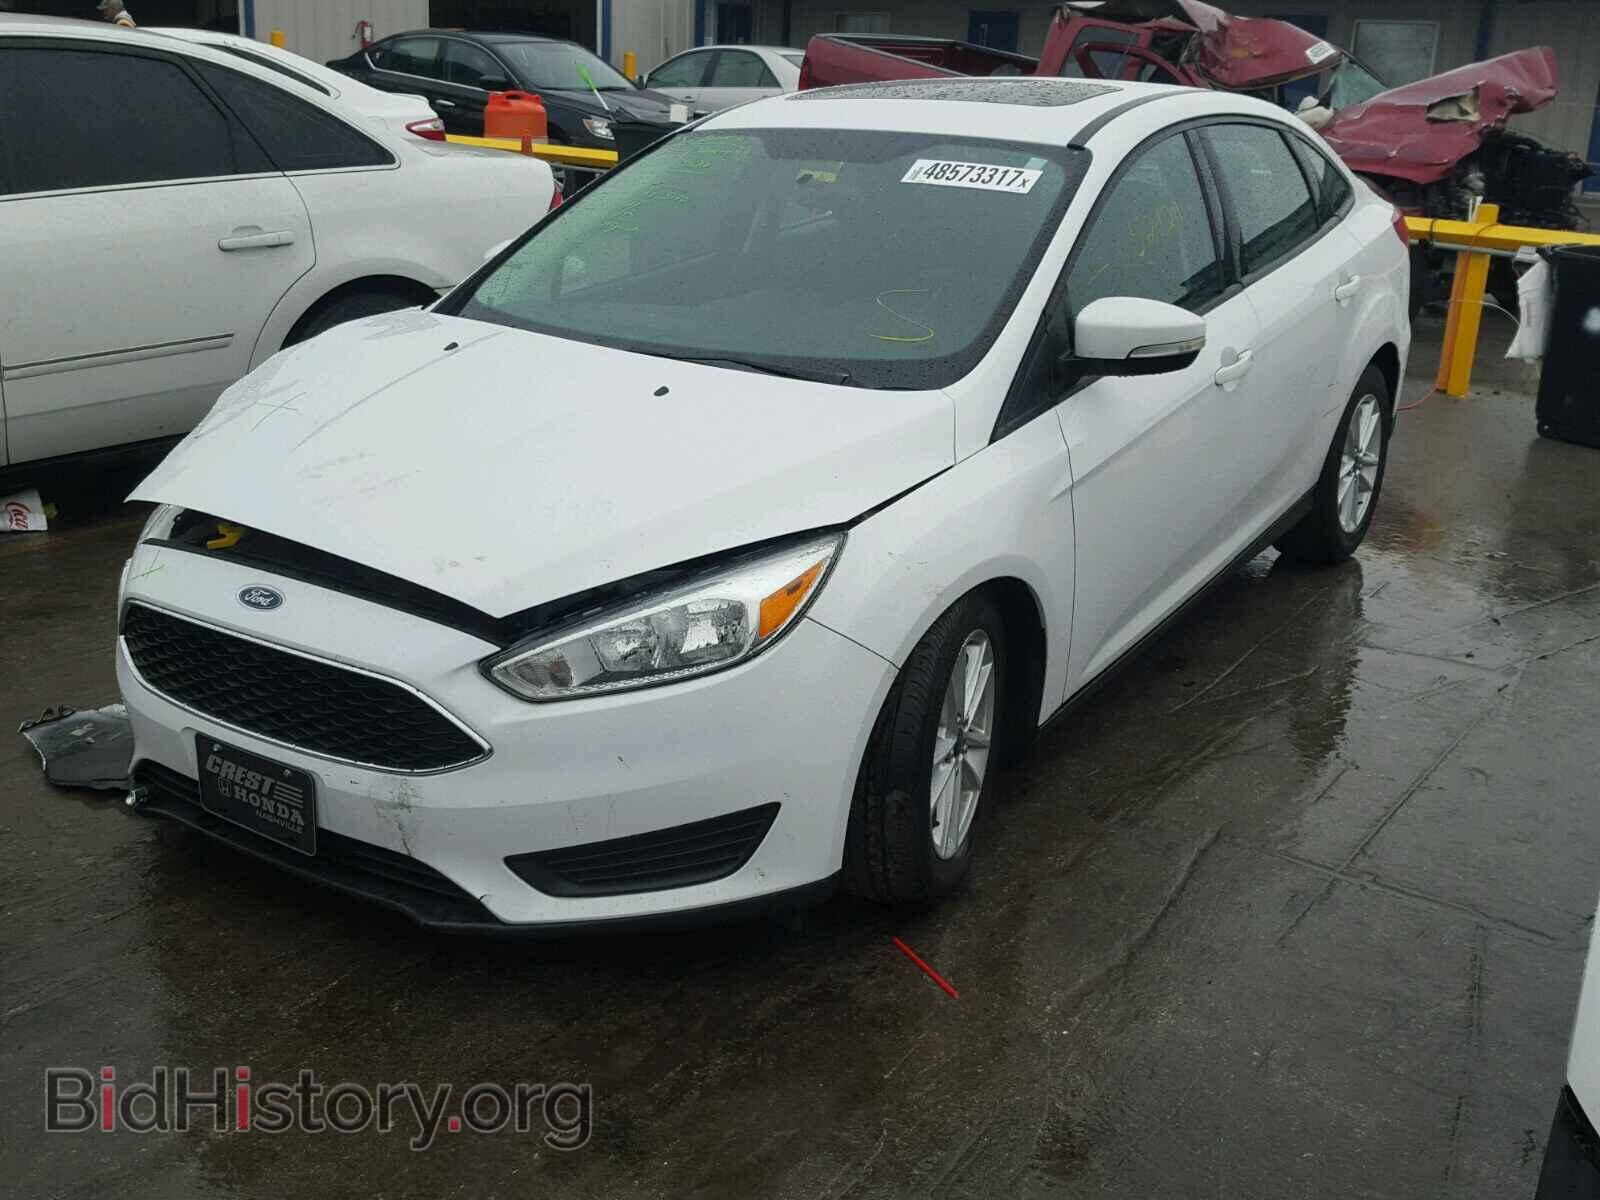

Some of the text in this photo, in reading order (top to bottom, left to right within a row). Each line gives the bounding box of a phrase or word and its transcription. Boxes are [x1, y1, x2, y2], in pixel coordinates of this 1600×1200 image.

[243, 589, 275, 607] Ford
[206, 754, 275, 795] CREST
[234, 785, 305, 826] HONDA
